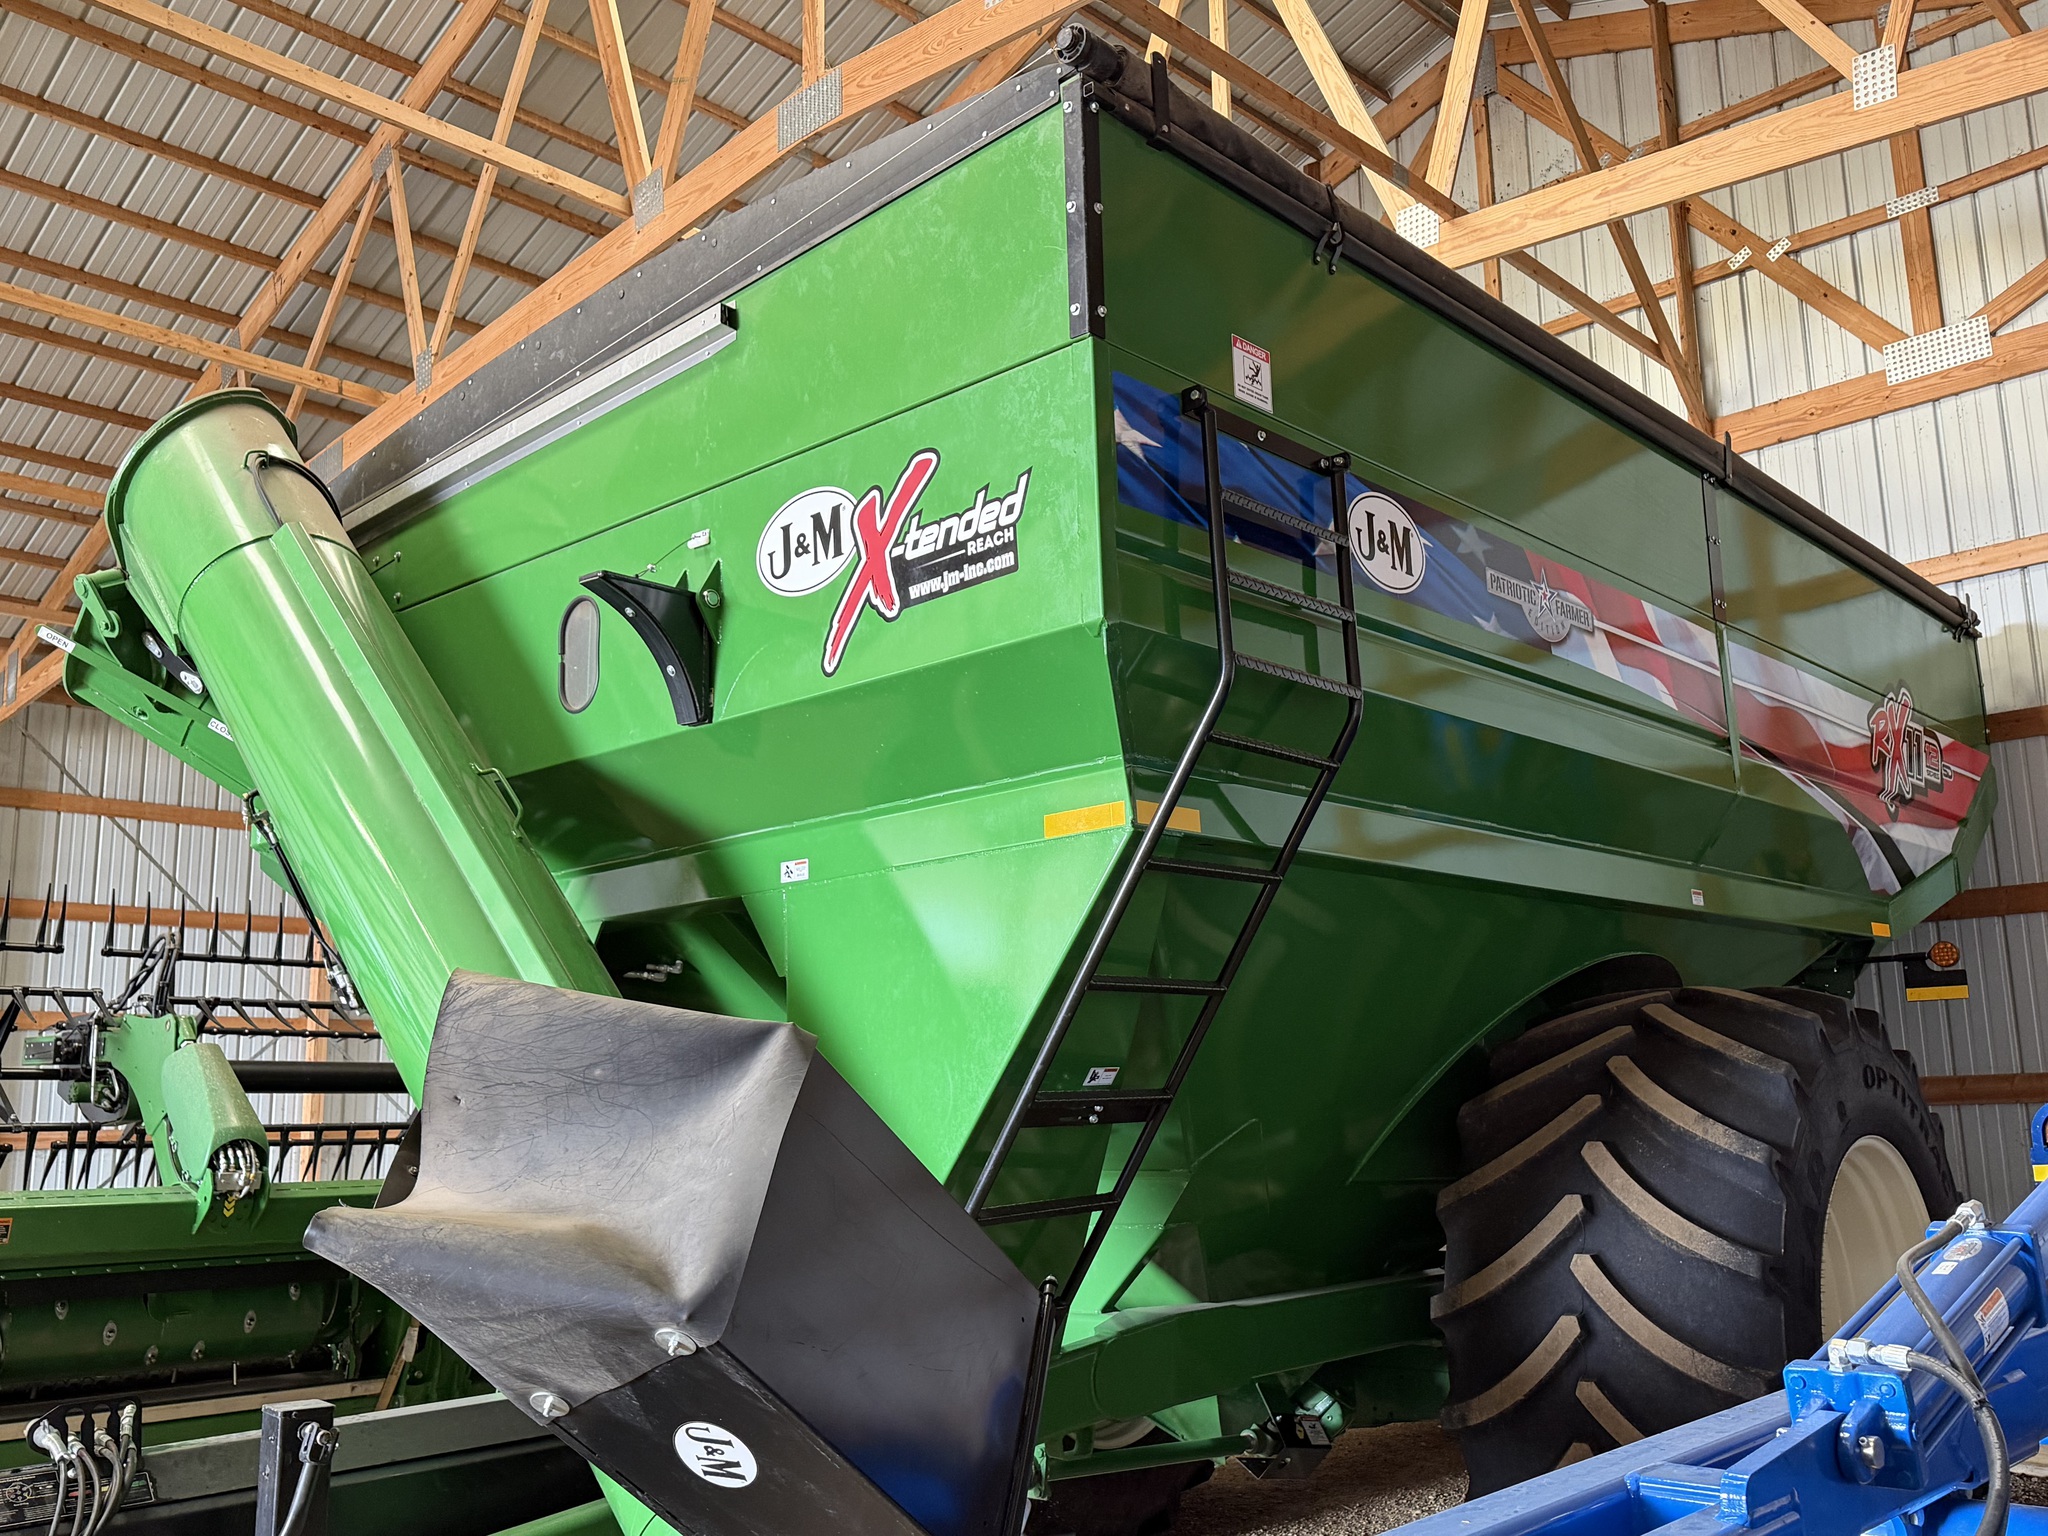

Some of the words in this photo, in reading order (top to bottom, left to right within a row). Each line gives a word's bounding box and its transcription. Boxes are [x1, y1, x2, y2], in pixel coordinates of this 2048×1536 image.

[1242, 342, 1267, 361] DANGER
[767, 502, 845, 580] J&M
[966, 526, 1015, 556] REACH
[1355, 510, 1415, 578] J&M
[1489, 572, 1537, 606] PATRIOTIC
[1555, 599, 1590, 627] FARMER
[45, 631, 70, 649] OPEN
[1527, 608, 1566, 636] EDITION
[685, 1426, 748, 1482] J&M
